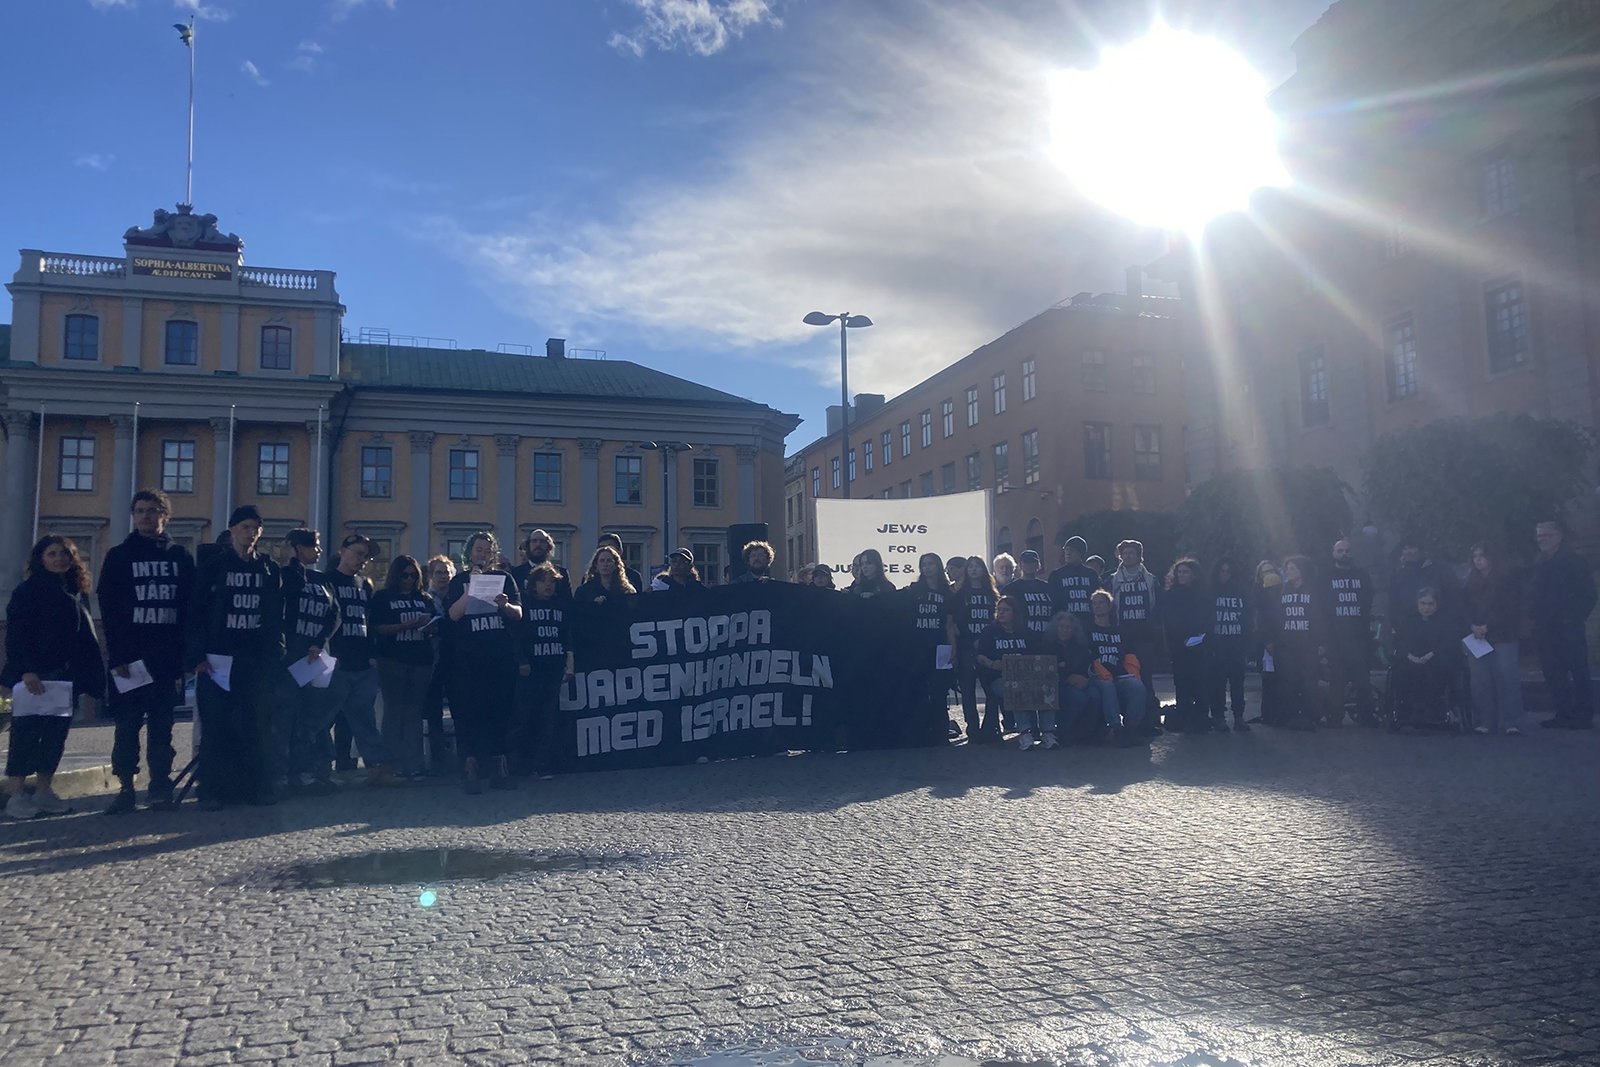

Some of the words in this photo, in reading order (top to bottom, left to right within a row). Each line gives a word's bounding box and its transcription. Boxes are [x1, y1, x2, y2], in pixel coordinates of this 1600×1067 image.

[877, 524, 928, 534] JEWS
[888, 545, 917, 553] FOR
[132, 561, 169, 578] INTE
[831, 564, 899, 573] JUCE
[902, 564, 915, 573] &
[226, 572, 252, 588] NOT
[1062, 577, 1079, 587] NOT
[1081, 577, 1091, 586] IN
[1331, 579, 1350, 589] NOT
[1352, 579, 1361, 589] IN
[338, 586, 357, 599] NOT
[1024, 593, 1047, 602] INTE
[1069, 590, 1088, 599] OUR
[1339, 592, 1358, 602] OUR
[233, 594, 260, 609] OUR
[390, 600, 411, 609] NOT
[413, 600, 426, 609] IN
[1125, 595, 1144, 606] OUR
[1216, 597, 1238, 608] INTE
[1282, 594, 1299, 604] NOT
[1301, 594, 1311, 604] IN
[346, 605, 365, 618] OUR
[529, 609, 551, 621] NOT
[553, 610, 562, 622] IN
[971, 608, 989, 619] OUR
[1122, 609, 1146, 620] NAME
[1285, 606, 1305, 616] OUR
[1336, 606, 1361, 616] NAME
[471, 616, 505, 632] NAME
[1284, 620, 1310, 631] NAME
[537, 626, 559, 637] OUR
[629, 609, 771, 659] STOPPA
[1092, 632, 1109, 642] NOT
[1111, 634, 1121, 643] IN
[534, 643, 564, 656] NAME
[996, 639, 1014, 650] NOT
[1016, 639, 1026, 649] IN
[1099, 646, 1119, 654] OUR
[576, 709, 663, 757] MED
